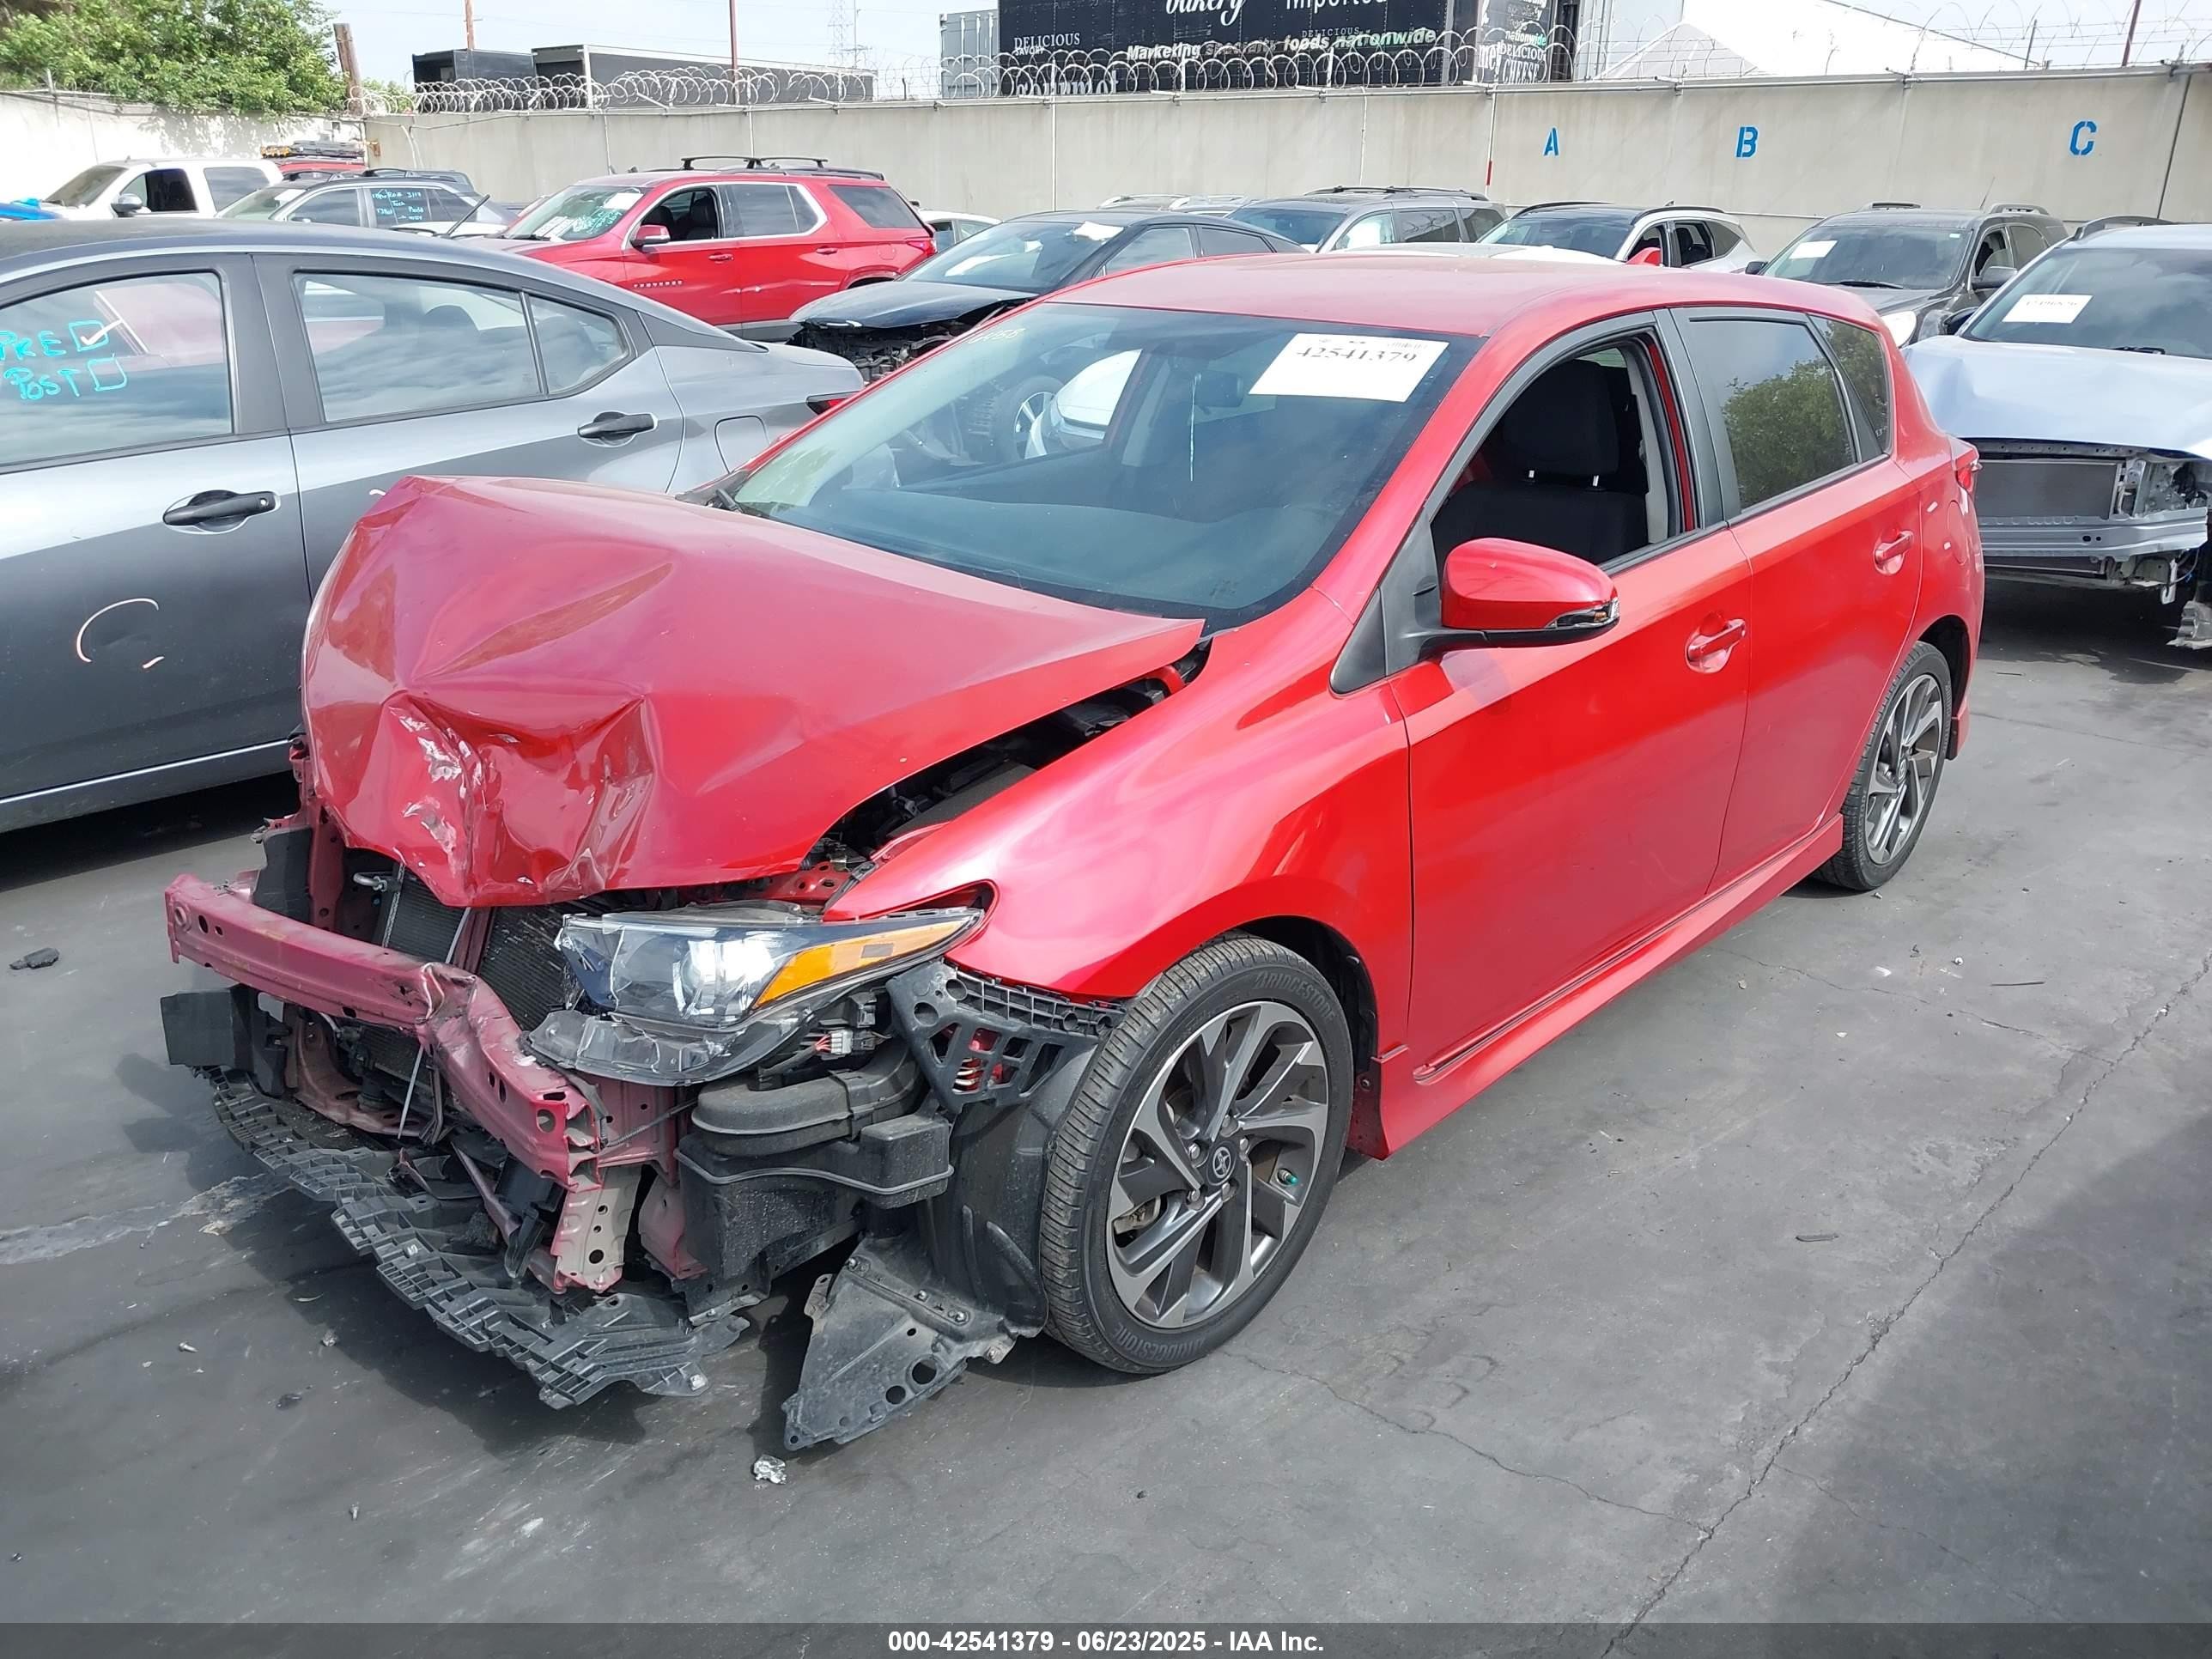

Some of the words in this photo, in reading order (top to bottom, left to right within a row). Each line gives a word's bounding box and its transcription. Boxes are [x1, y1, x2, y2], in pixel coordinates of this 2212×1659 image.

[1014, 33, 1080, 50] DELICIOUS
[1127, 42, 1202, 60] Marketing
[1284, 33, 1330, 51] foods
[1335, 27, 1436, 49] nationwide
[1302, 27, 1360, 38] DELICIOUS
[1502, 58, 1540, 85] CHEESE
[1544, 127, 1559, 156] A
[1735, 126, 1759, 158] B
[2069, 120, 2097, 155] C
[3, 367, 83, 400] POST
[1254, 970, 1337, 1024] BRIDGESTONE
